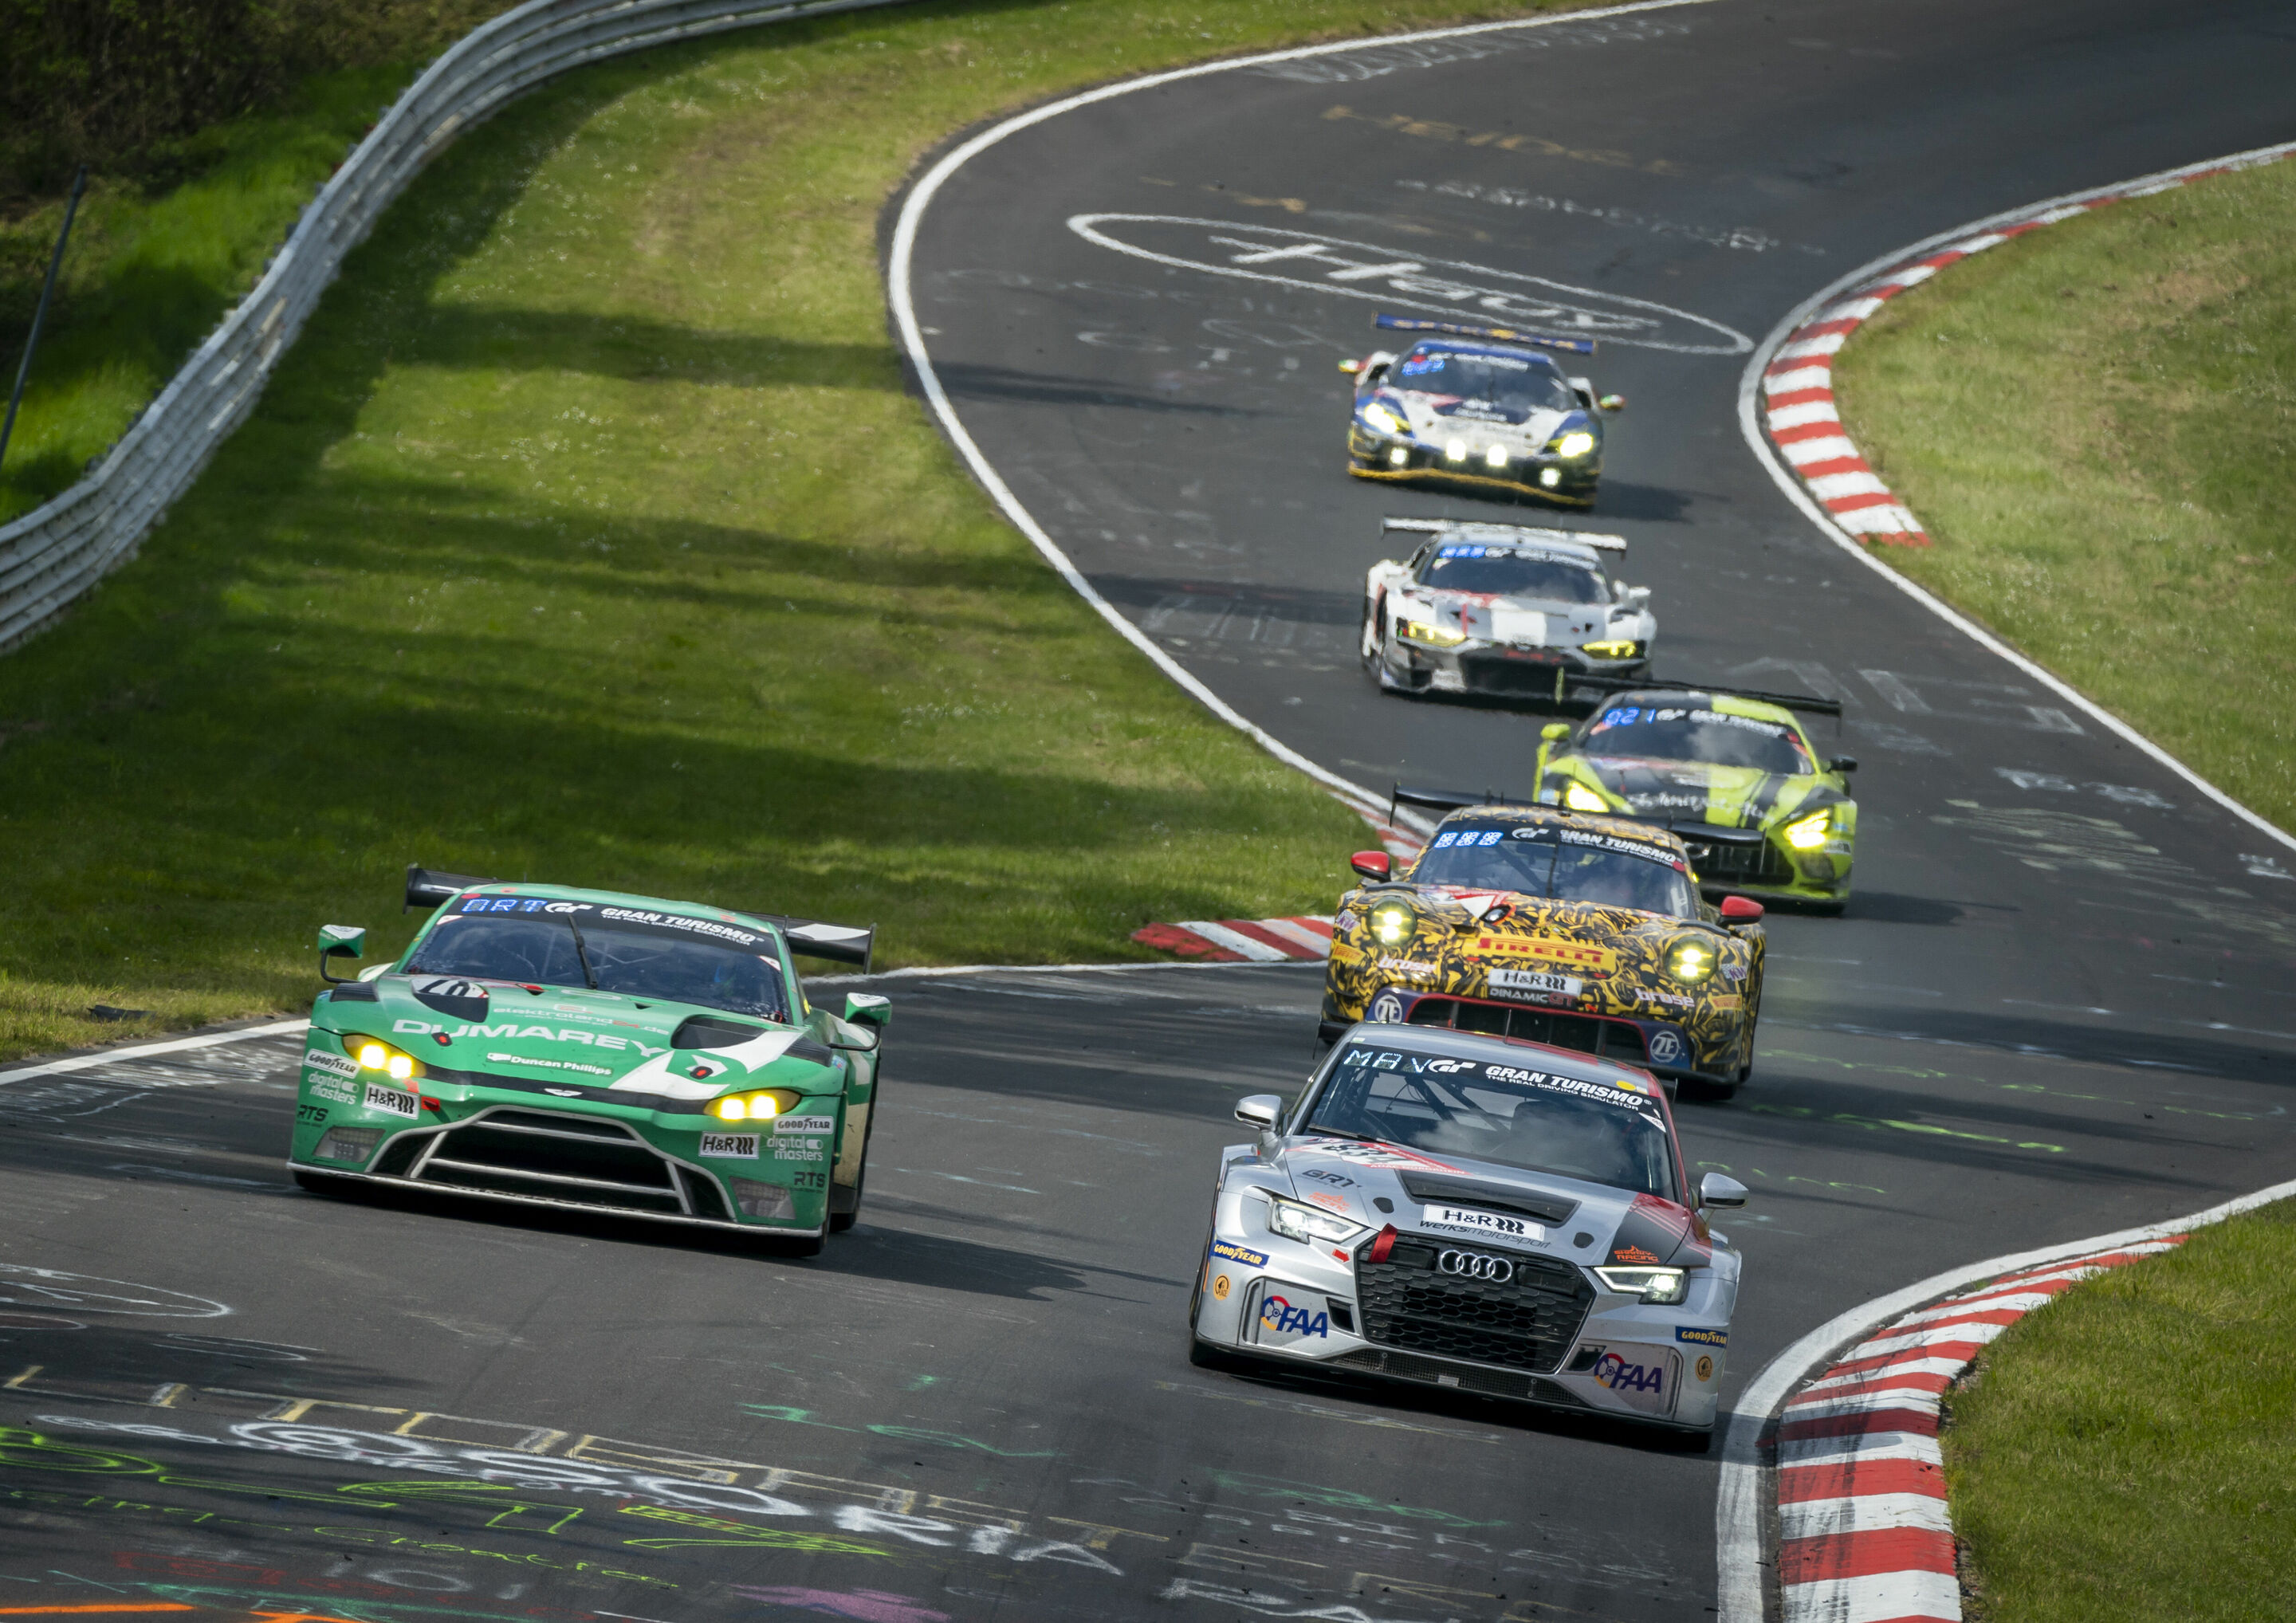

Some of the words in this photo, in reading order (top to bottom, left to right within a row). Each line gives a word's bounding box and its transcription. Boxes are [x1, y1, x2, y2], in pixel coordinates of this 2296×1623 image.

[600, 907, 660, 922] GRAN
[1477, 937, 1604, 964] PIRELLI
[1378, 954, 1437, 973] brose
[1634, 987, 1695, 1008] brose
[392, 1020, 668, 1058] DUMAREY
[1652, 1035, 1677, 1058] ZF
[309, 1053, 357, 1074] GOODYEAR
[511, 1055, 561, 1069] Duncan
[563, 1059, 613, 1076] Phillips
[308, 1071, 343, 1090] digital
[1485, 1065, 1547, 1083] GRAN
[309, 1086, 357, 1106] masters
[367, 1087, 396, 1108] H&R
[1507, 1078, 1535, 1087] REAL
[1537, 1083, 1578, 1095] DRIVING
[1580, 1091, 1640, 1111] SIMULATOR
[777, 1118, 831, 1131] GOODYEAR
[702, 1135, 734, 1152] H&R
[766, 1135, 806, 1151] digital
[773, 1149, 824, 1162] masters
[793, 1171, 826, 1189] RTS
[1444, 1209, 1492, 1227] H&R
[1419, 1220, 1552, 1249] werksmotorsport
[1213, 1244, 1263, 1265] GOODYEAR
[1681, 1330, 1728, 1346] GOODYEAR
